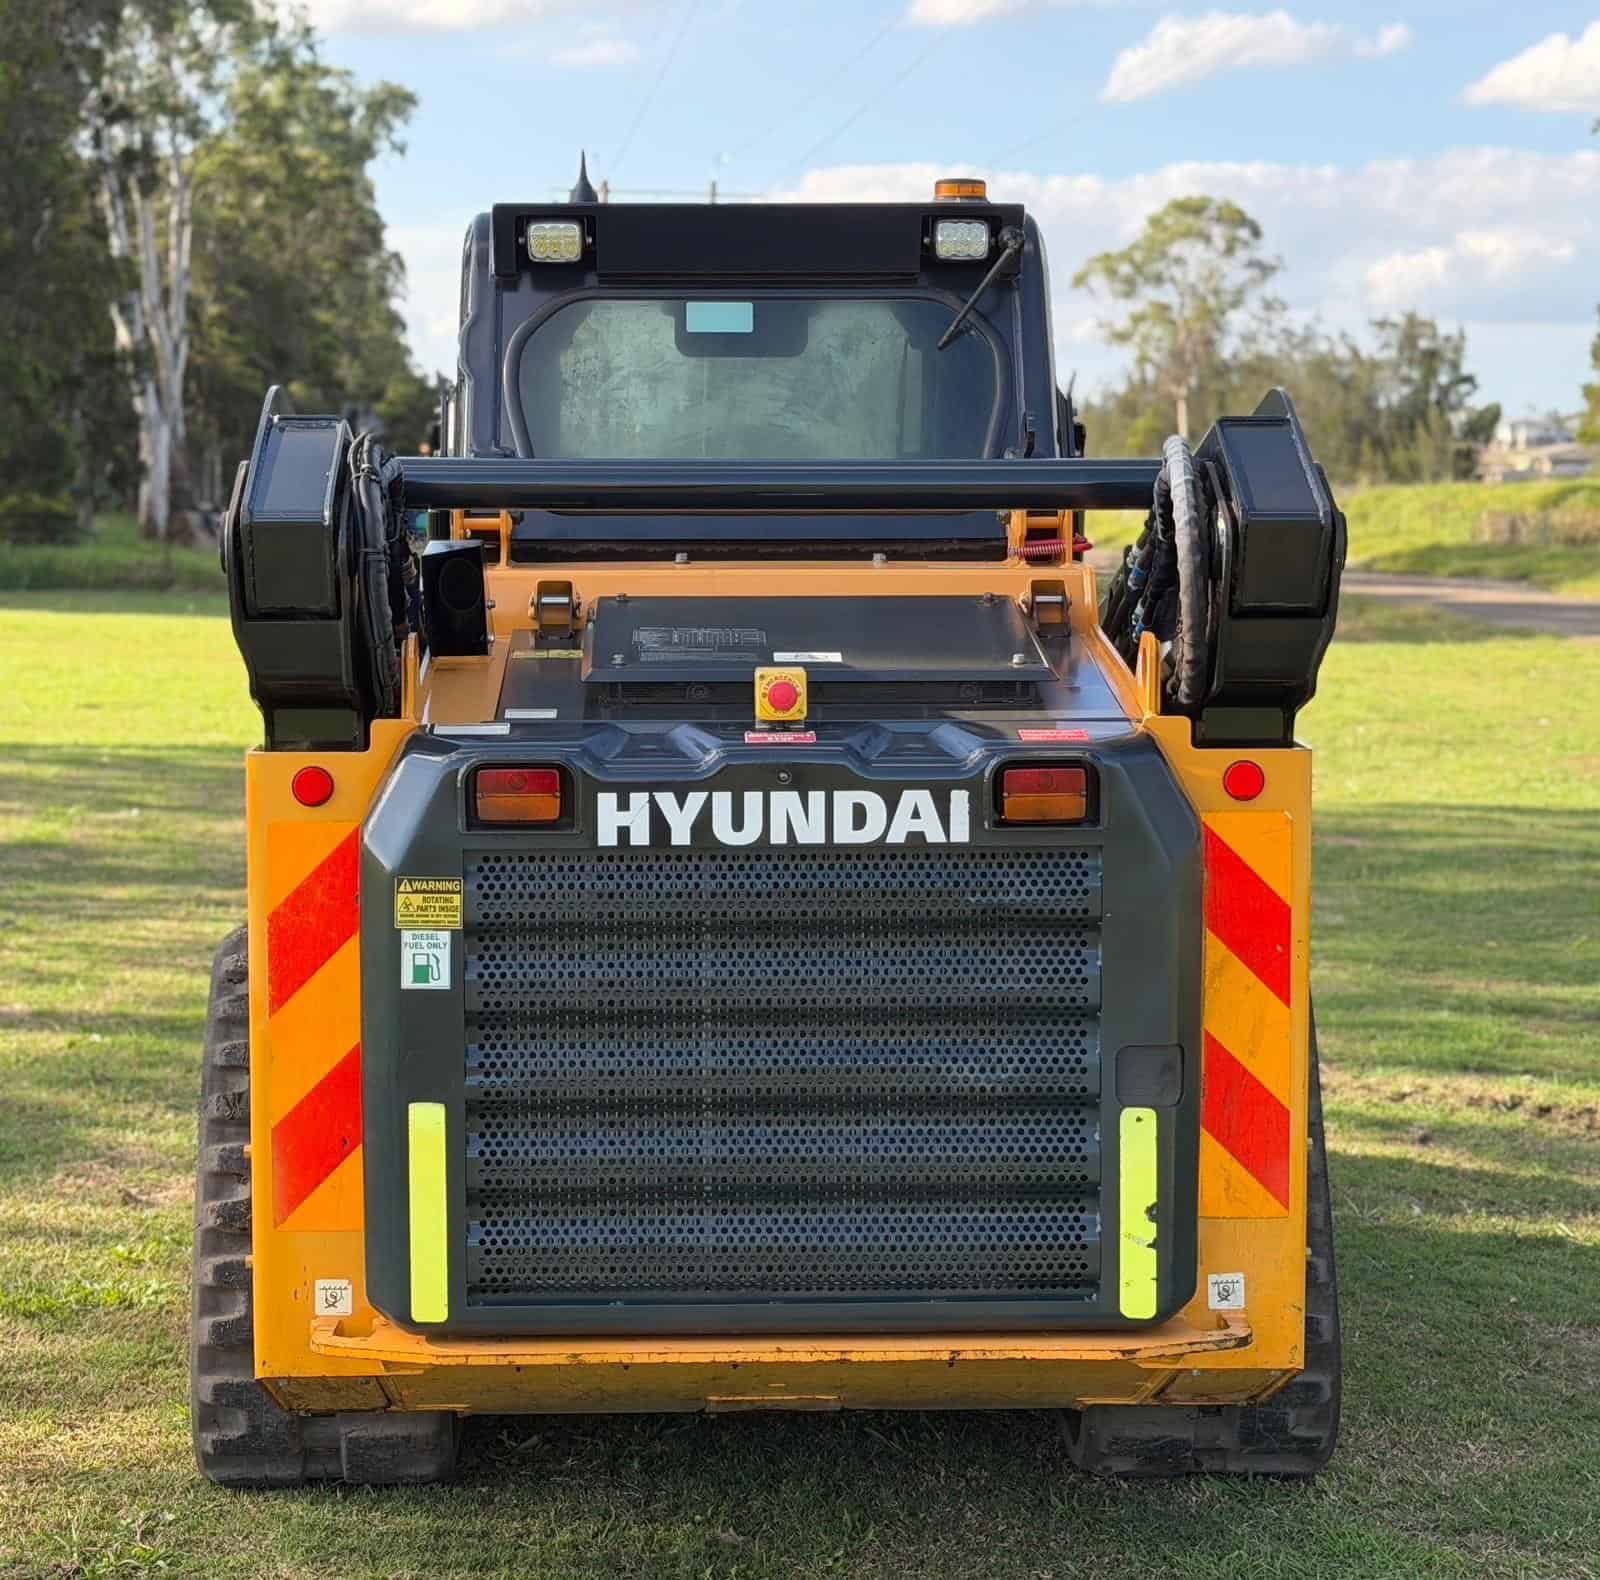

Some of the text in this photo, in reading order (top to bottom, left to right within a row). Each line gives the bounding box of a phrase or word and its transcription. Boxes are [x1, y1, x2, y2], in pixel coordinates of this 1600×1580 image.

[597, 789, 969, 847] HYUNDAI
[412, 879, 460, 891] WARNING
[422, 896, 454, 904] ROTATING
[416, 905, 459, 913] PARTS INSIDE
[411, 933, 440, 941] DIESEL
[404, 942, 448, 950] FUEL ONLY
